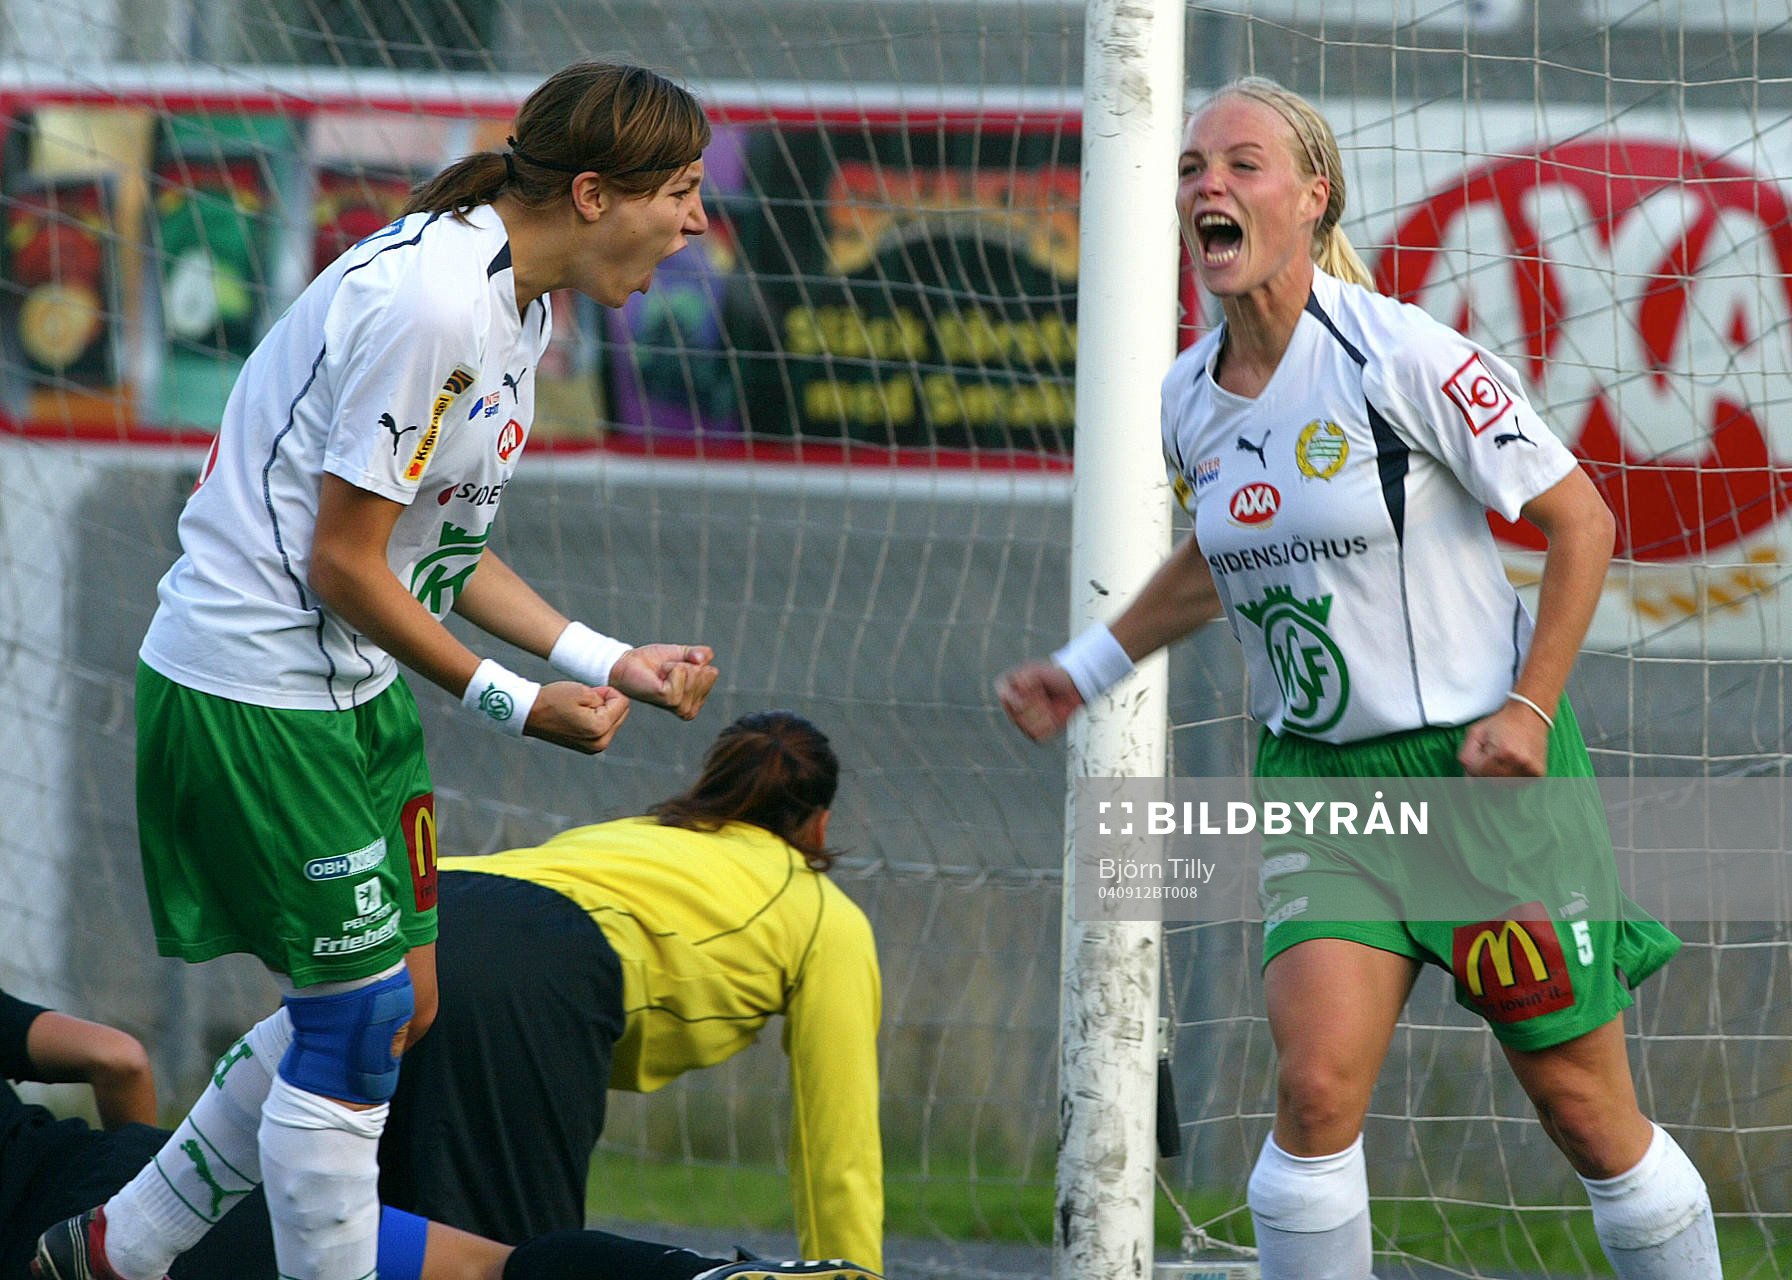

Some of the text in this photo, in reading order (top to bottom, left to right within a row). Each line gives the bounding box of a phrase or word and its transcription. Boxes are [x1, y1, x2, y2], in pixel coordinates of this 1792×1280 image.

[1233, 486, 1278, 518] AXA
[1209, 535, 1368, 576] SIDENSJÖHUS
[309, 860, 349, 876] OBH
[1570, 920, 1595, 967] 5
